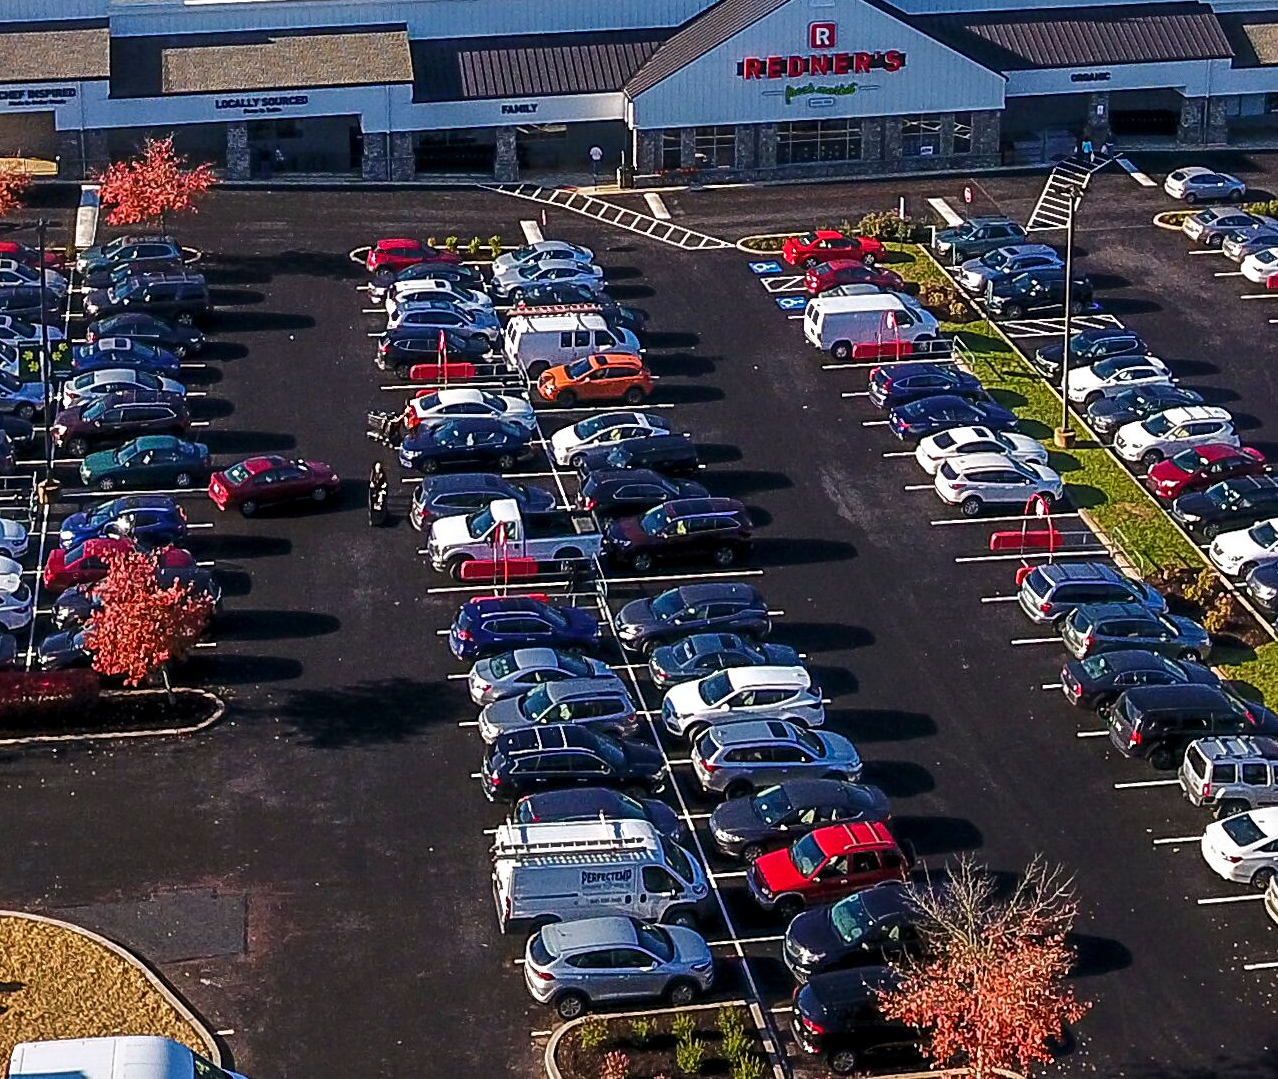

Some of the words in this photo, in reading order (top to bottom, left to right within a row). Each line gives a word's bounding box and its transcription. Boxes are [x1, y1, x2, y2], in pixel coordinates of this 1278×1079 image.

[815, 27, 830, 45] R
[743, 49, 903, 80] REDNER'S
[215, 98, 260, 109] LOCALLY
[262, 95, 309, 106] SOURCED
[501, 103, 538, 114] FAMILY
